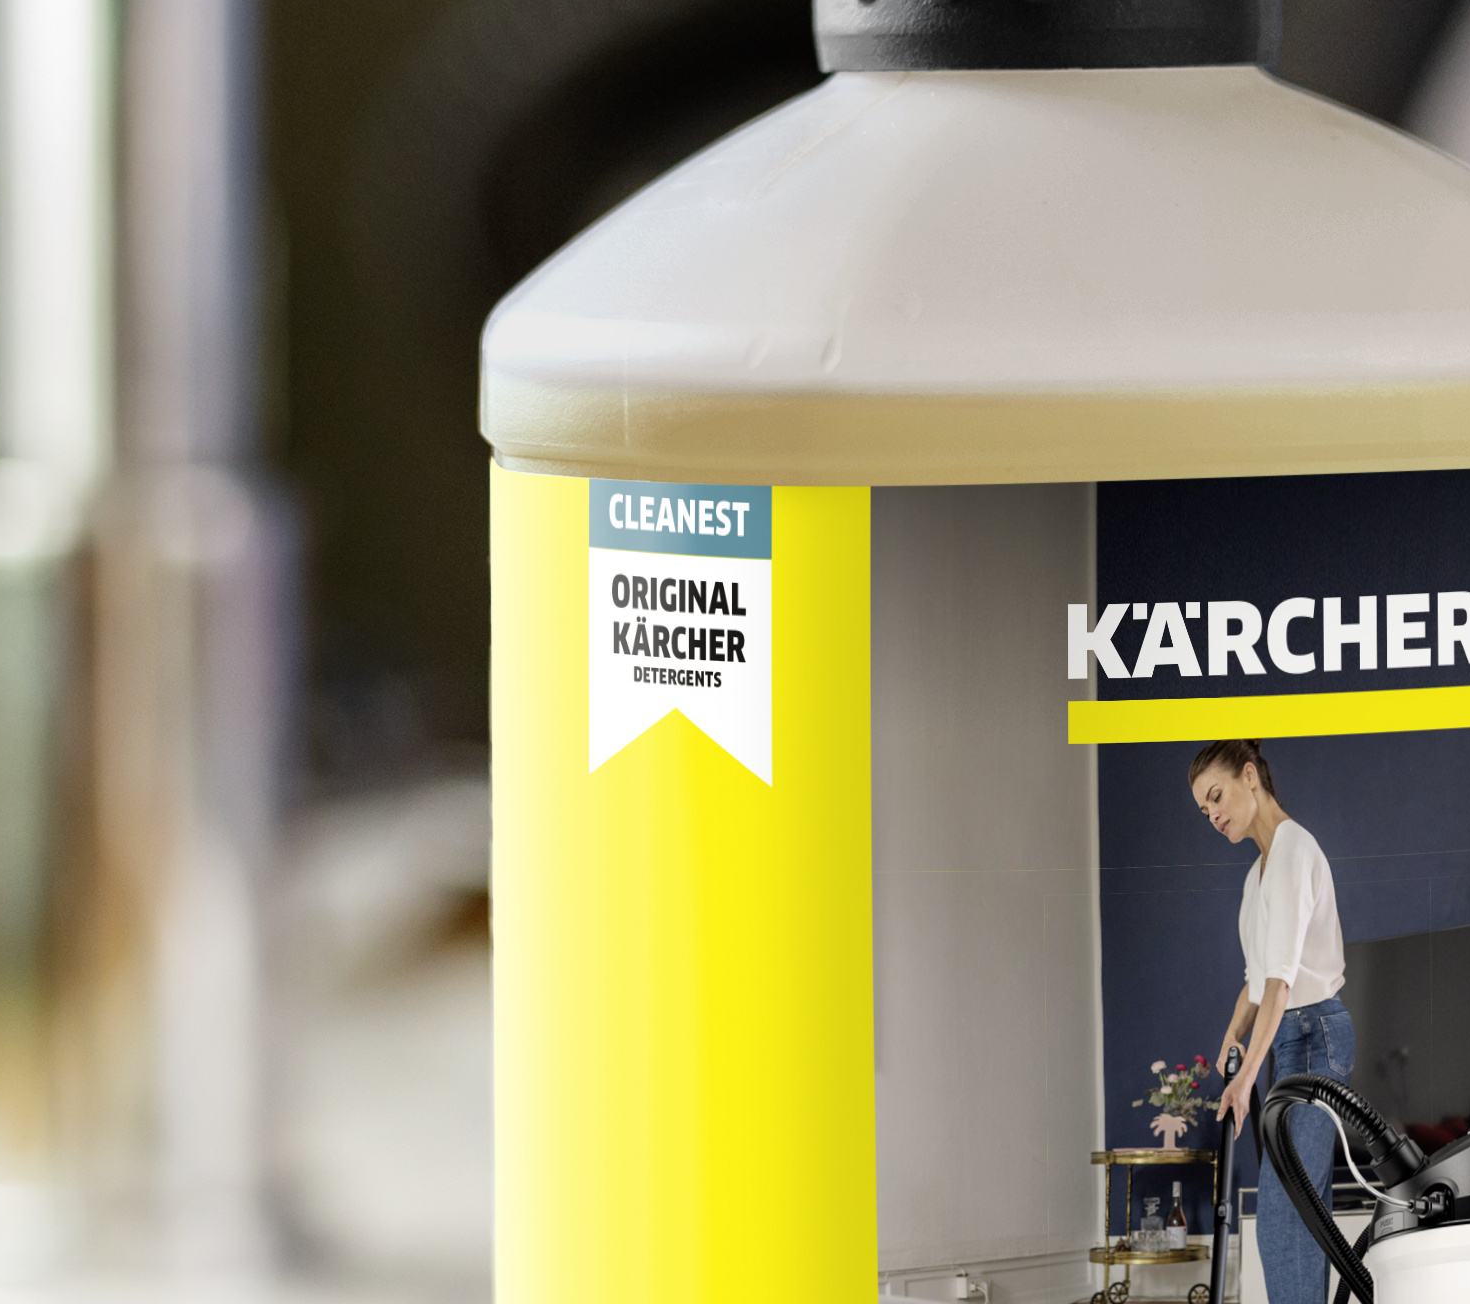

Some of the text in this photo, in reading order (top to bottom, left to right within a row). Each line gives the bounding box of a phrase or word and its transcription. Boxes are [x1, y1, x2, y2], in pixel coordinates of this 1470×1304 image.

[608, 493, 751, 537] CLEANEST
[611, 573, 747, 617] ORIGINAL
[612, 615, 747, 663] KÄRCHER
[633, 665, 722, 688] DETERGENTS
